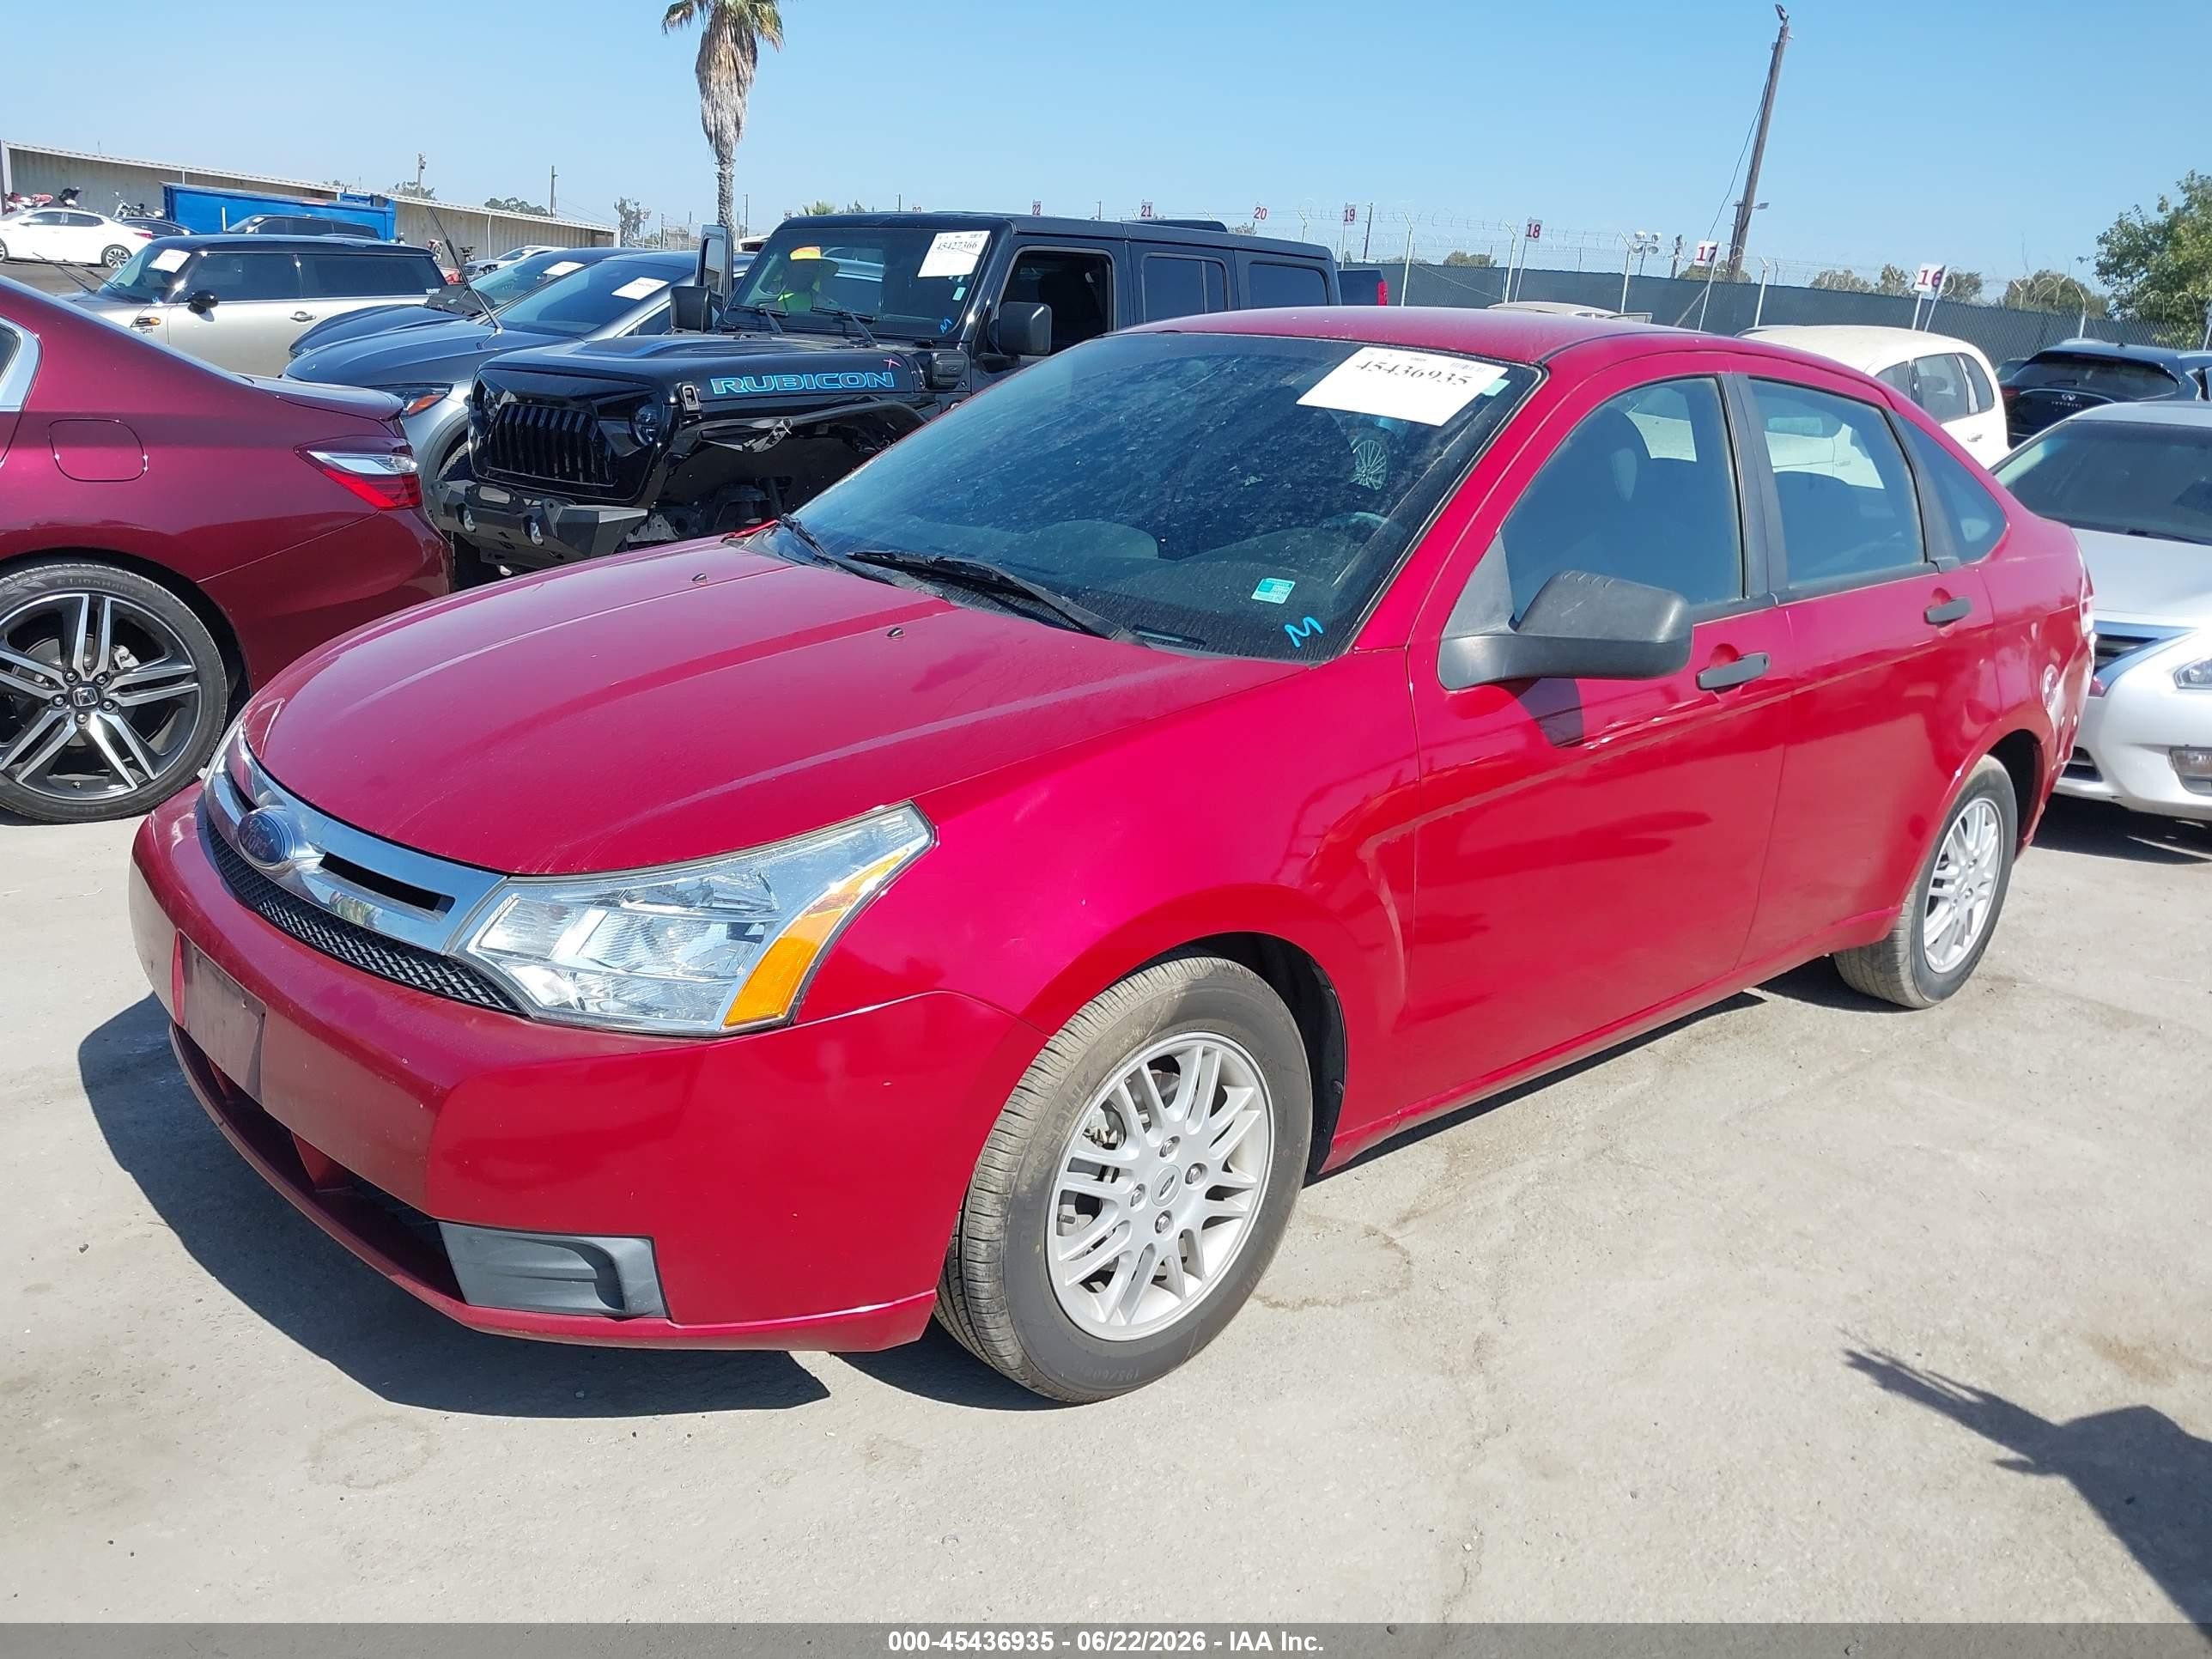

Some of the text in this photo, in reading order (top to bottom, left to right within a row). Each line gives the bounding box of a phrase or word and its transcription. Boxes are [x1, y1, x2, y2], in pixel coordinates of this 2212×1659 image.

[1032, 204, 1041, 215] 22
[1141, 205, 1152, 216] 21
[1254, 207, 1267, 220] 20
[1344, 209, 1355, 222] 19
[1525, 223, 1540, 239] 18
[1696, 246, 1717, 262] 17
[1917, 270, 1942, 288] 16
[1356, 361, 1473, 386] 45436935
[710, 372, 895, 395] RUBICON
[1284, 617, 1323, 648] M
